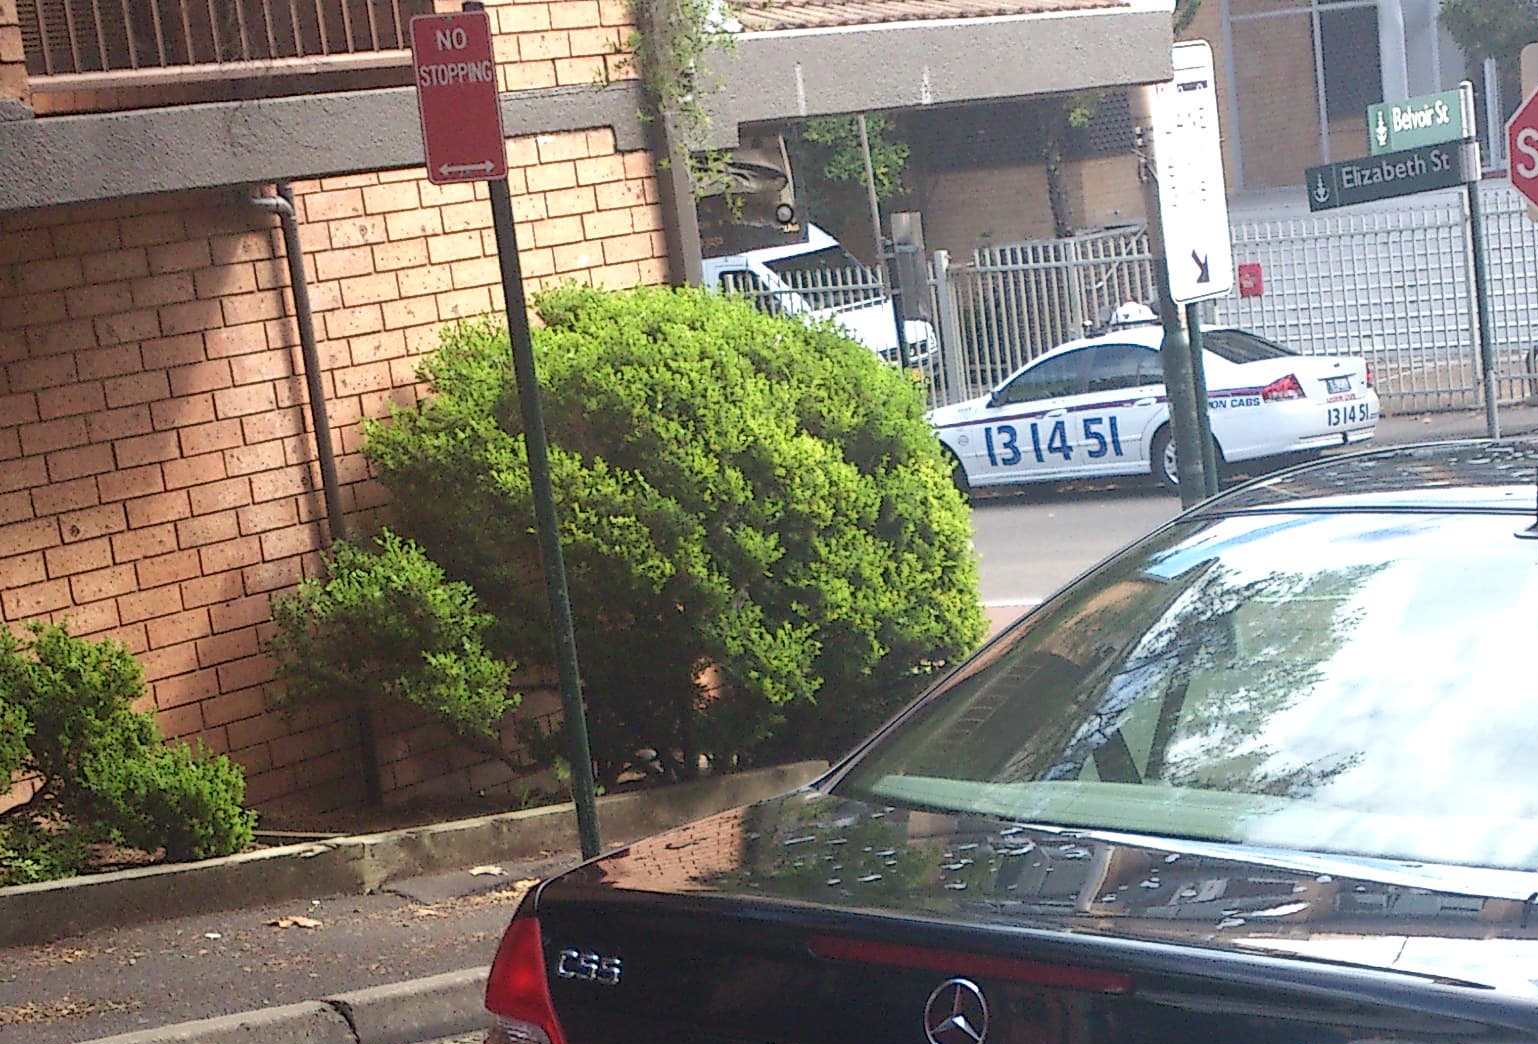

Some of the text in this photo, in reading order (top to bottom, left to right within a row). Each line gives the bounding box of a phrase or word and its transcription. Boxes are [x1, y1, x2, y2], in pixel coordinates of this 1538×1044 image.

[435, 28, 467, 51] NO
[419, 61, 493, 87] STOPPING
[1392, 100, 1450, 132] Belvoir St
[1341, 149, 1450, 189] Elizabeth St
[1208, 397, 1261, 409] ON CABS
[1327, 402, 1369, 427] 13 14 51
[984, 415, 1123, 467] 13 14 51
